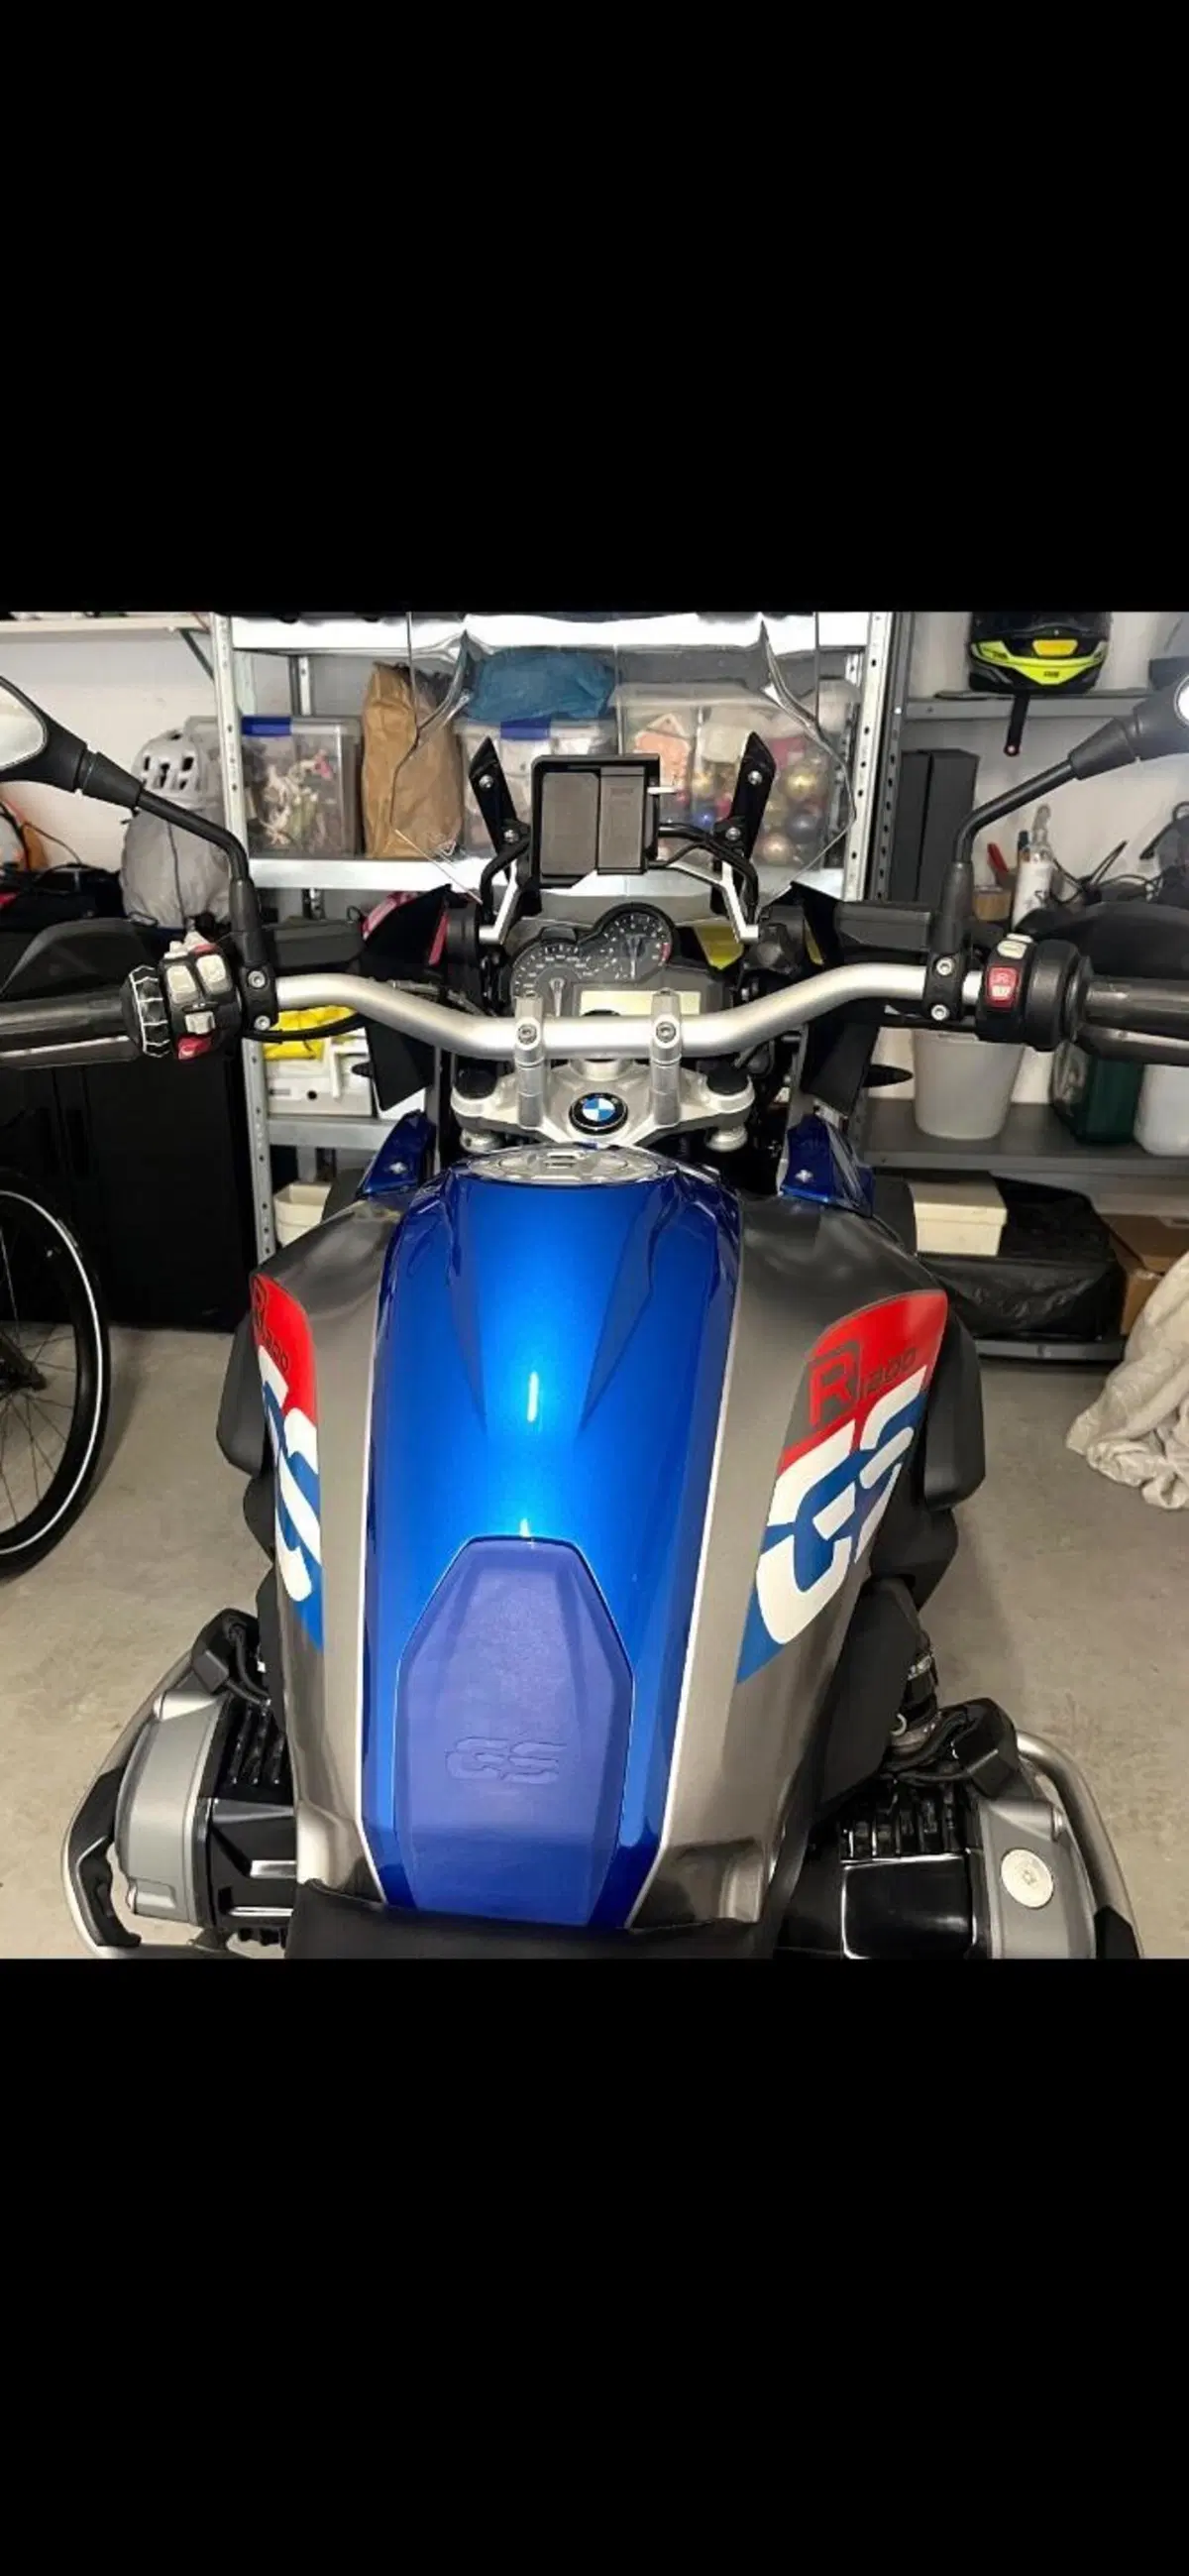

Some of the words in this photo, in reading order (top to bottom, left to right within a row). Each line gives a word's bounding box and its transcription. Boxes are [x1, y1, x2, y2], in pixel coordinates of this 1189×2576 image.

[810, 1350, 855, 1427] R
[861, 1346, 917, 1401] 1200
[756, 1365, 927, 1645] GS
[445, 1736, 568, 1785] GS
